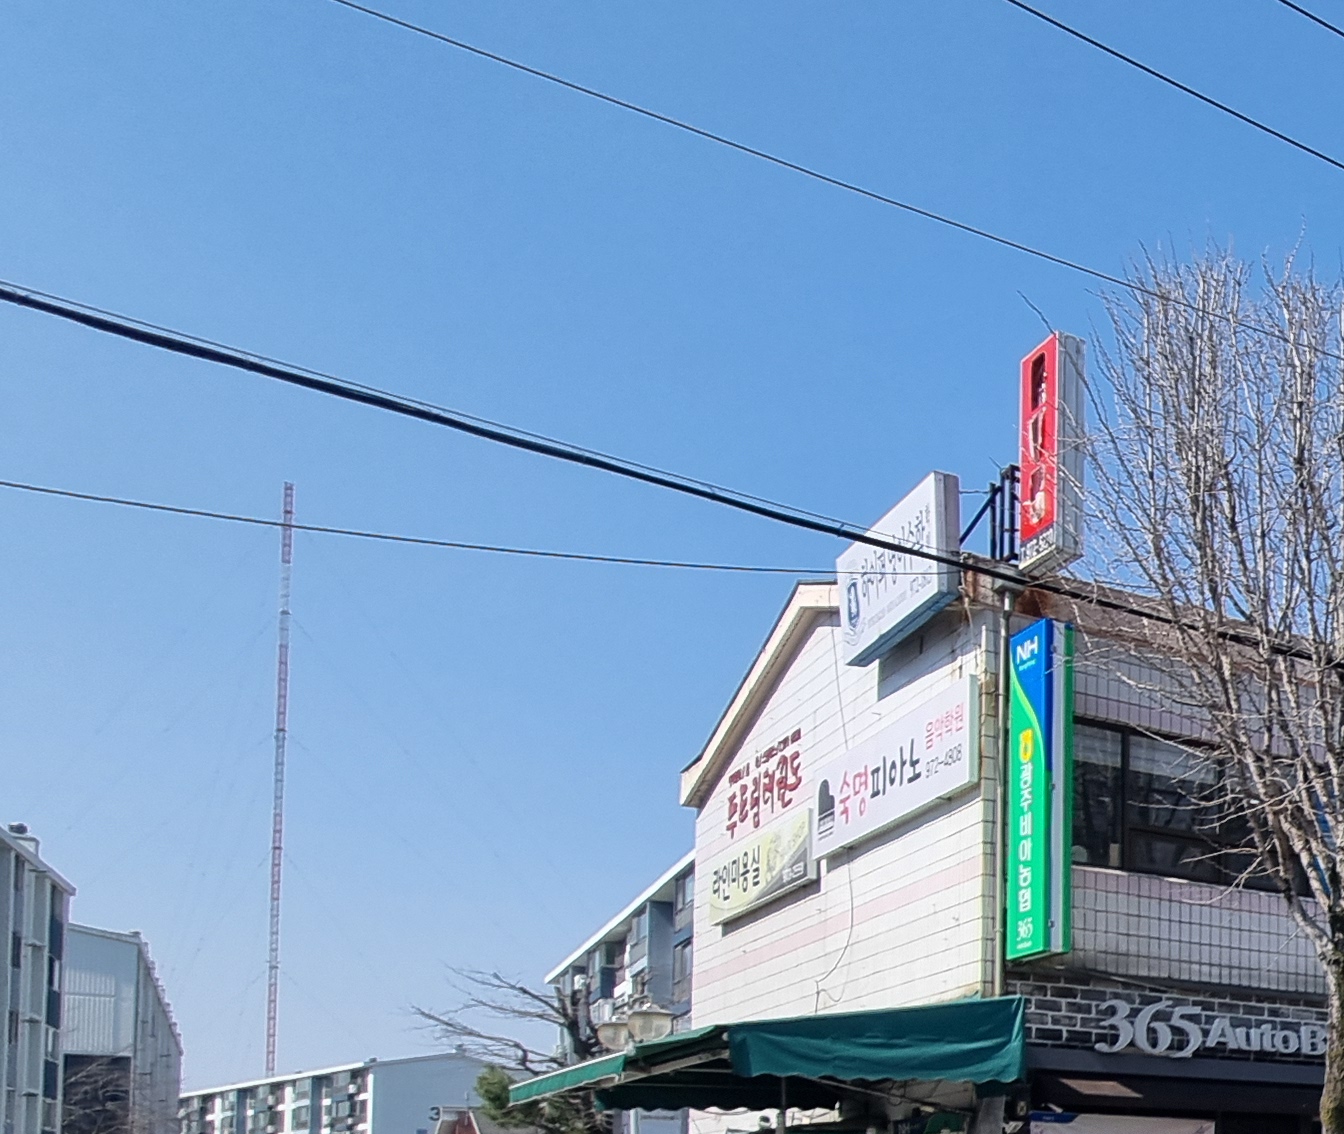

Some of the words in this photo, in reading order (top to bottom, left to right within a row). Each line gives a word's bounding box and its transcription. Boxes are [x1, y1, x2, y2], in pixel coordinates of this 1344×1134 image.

[1016, 635, 1039, 665] NH
[838, 738, 922, 825] 숙명피아노
[712, 845, 761, 902] 라인미용실
[1094, 999, 1202, 1059] 365
